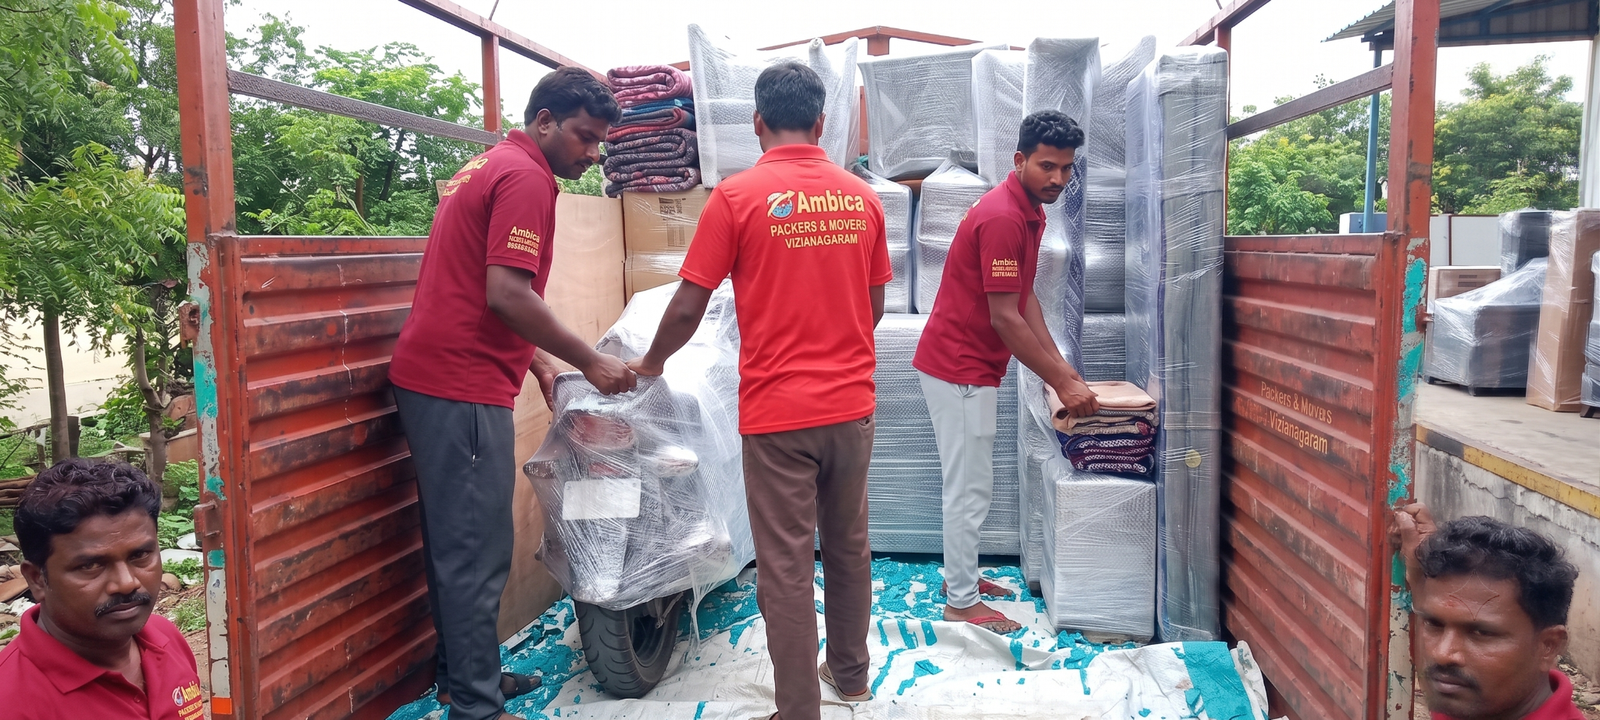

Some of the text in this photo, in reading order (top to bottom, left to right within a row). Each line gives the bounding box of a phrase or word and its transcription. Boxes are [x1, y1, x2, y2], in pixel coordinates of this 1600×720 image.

[797, 190, 865, 214] Ambica
[510, 225, 540, 243] Ambica
[770, 218, 867, 237] PACKERS & MOVERS
[785, 233, 858, 249] VIZIANAGARAM
[992, 258, 1018, 266] Ambica
[1260, 381, 1292, 408] Packers
[1293, 392, 1300, 411] &
[1269, 410, 1328, 455] Vizianagaram
